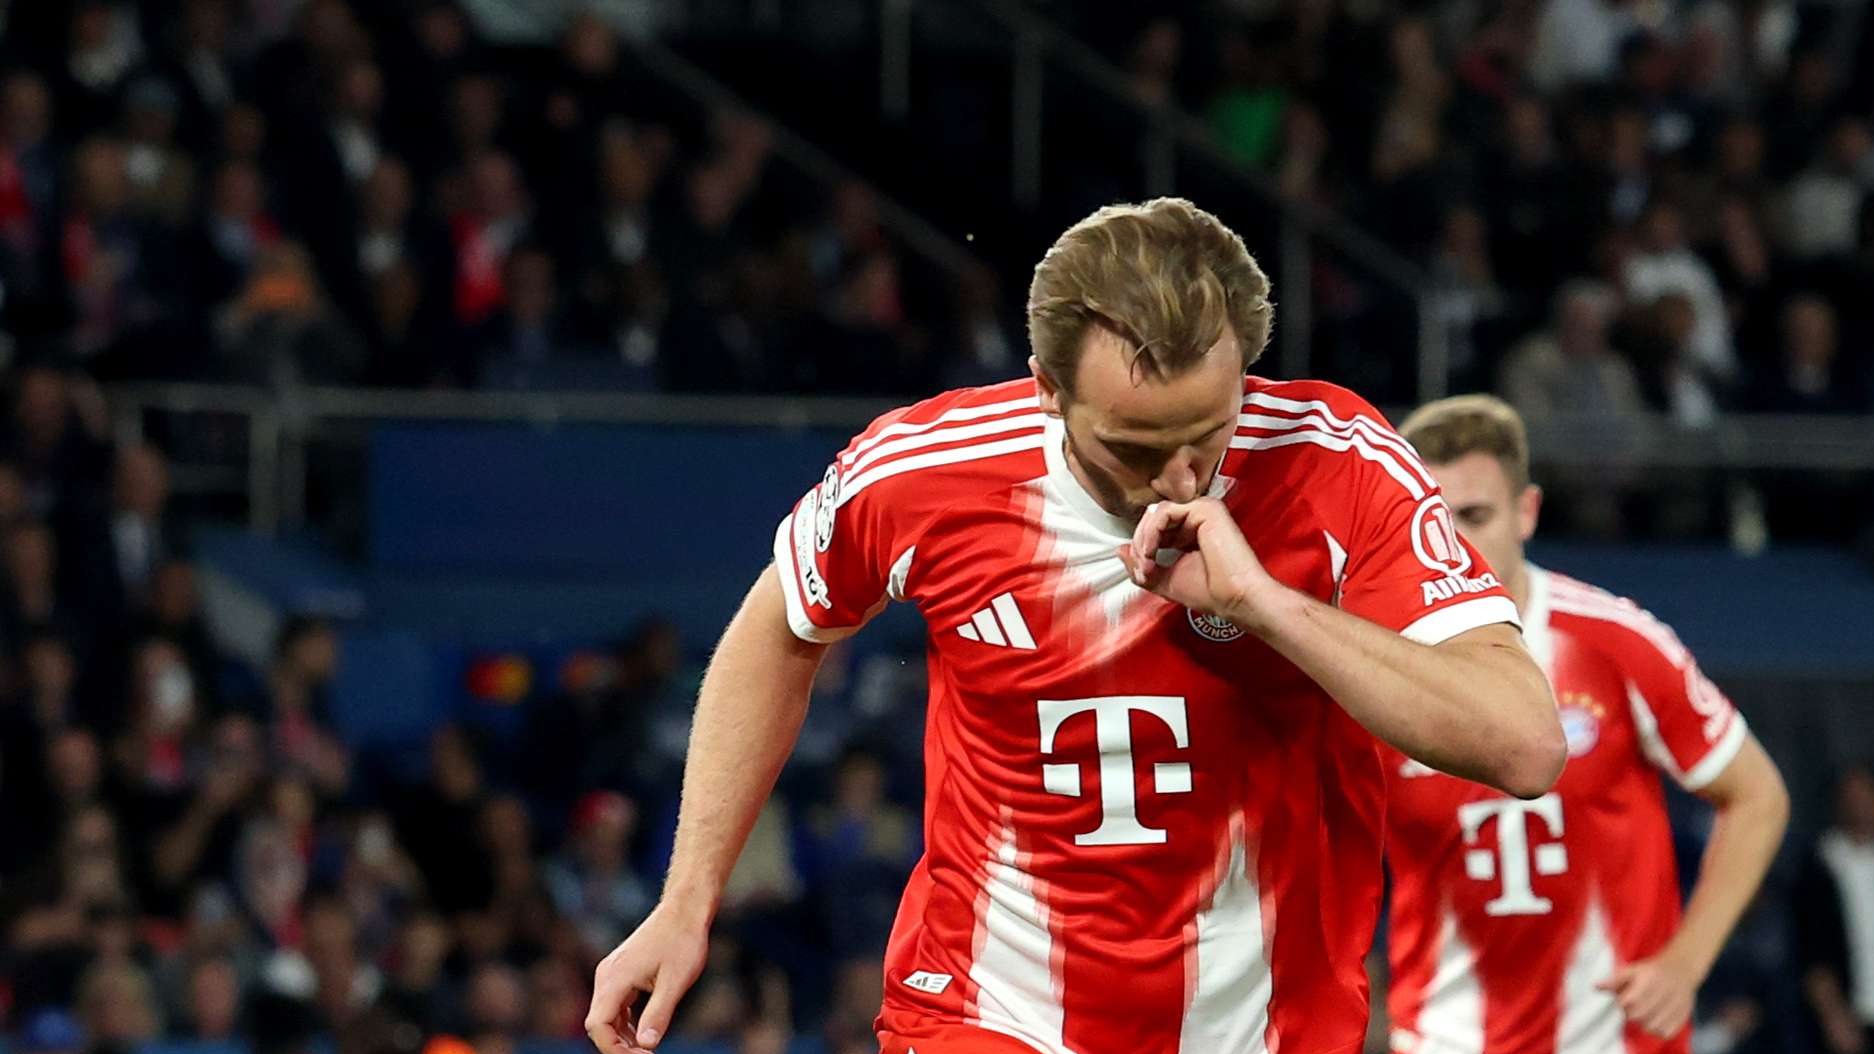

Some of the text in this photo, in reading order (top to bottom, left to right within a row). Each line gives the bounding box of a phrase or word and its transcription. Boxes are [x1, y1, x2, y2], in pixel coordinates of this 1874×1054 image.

[1420, 571, 1502, 606] Allinz
[1038, 695, 1192, 846] T
[1457, 793, 1568, 917] T
